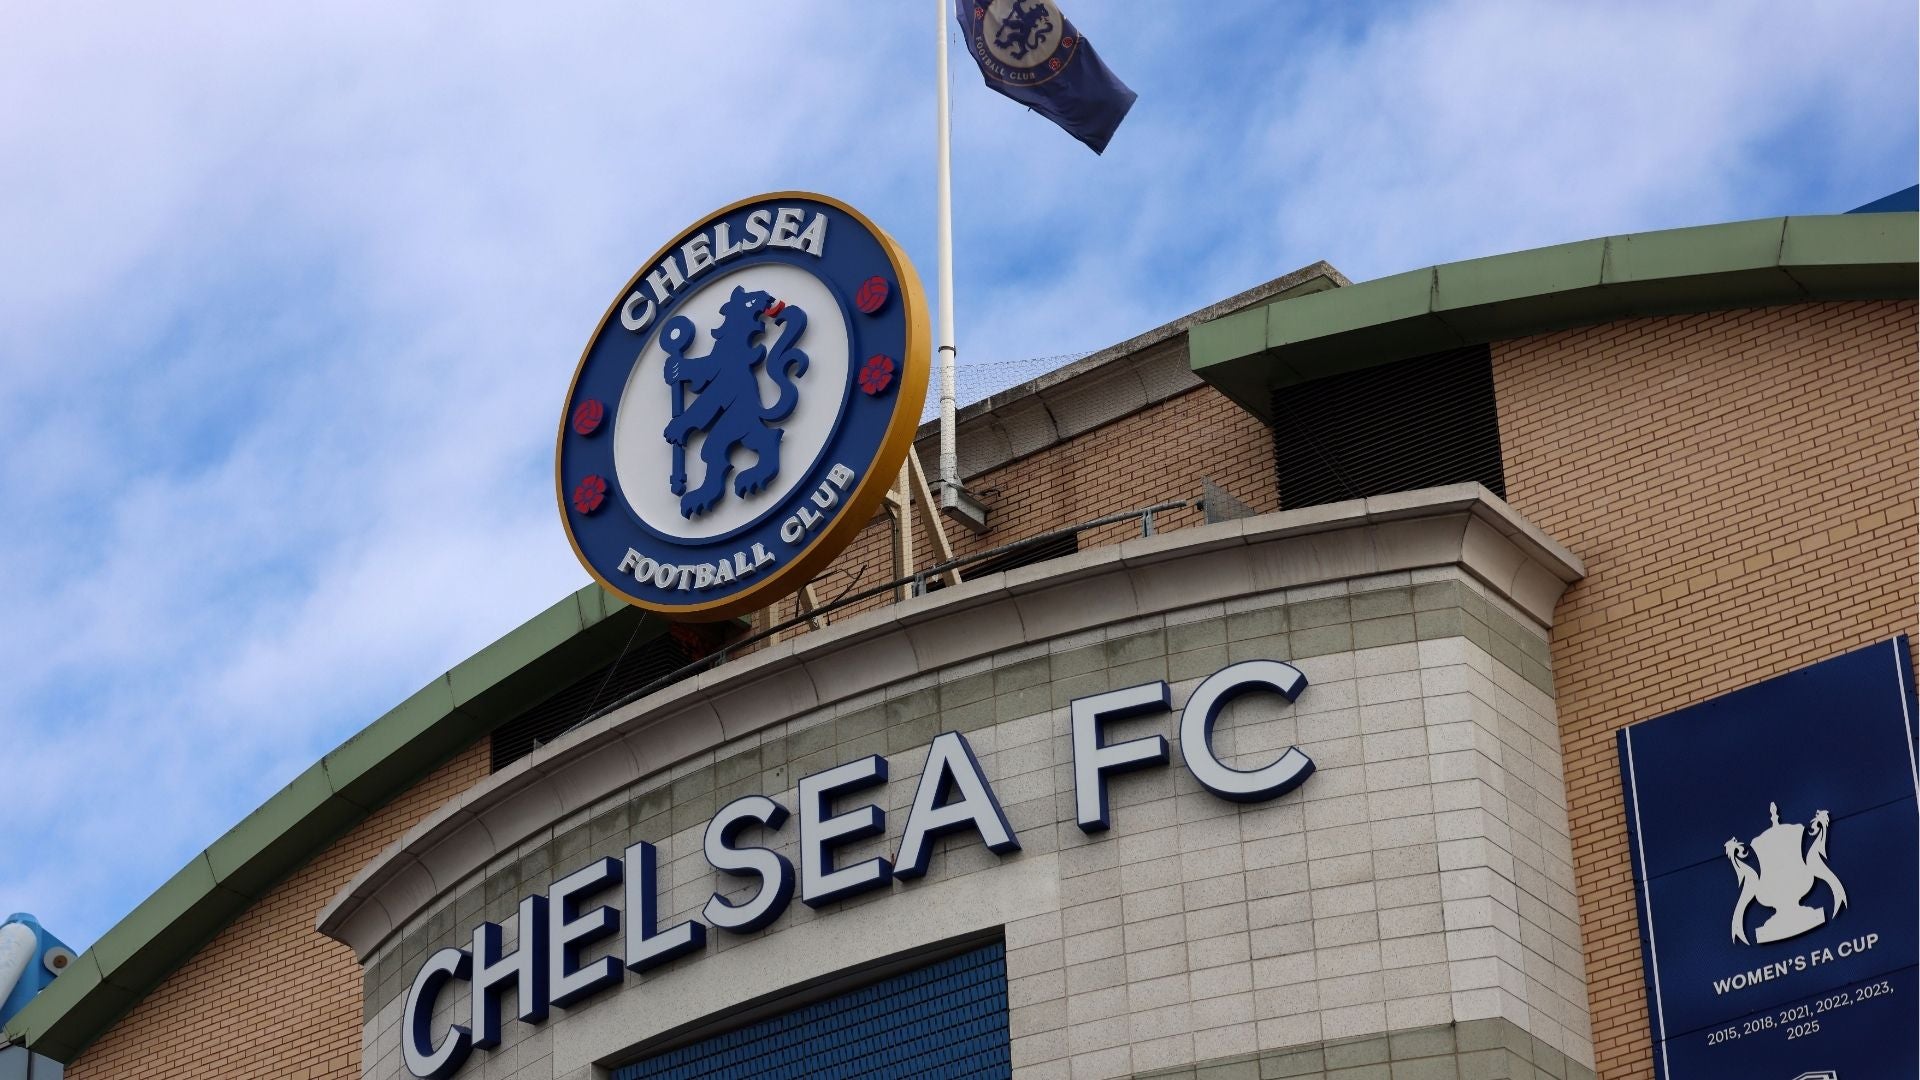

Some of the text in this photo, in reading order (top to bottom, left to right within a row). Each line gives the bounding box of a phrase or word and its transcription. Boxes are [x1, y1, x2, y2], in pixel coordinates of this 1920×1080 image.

[975, 36, 1036, 80] FOOTBALL CLUB
[620, 207, 829, 333] CHELSEA
[617, 462, 855, 591] FOOTBALL CLUB
[401, 658, 1316, 1080] CHELSEA FC
[1713, 933, 1879, 995] WOMEN'S FA CUP
[1707, 981, 1894, 1045] 2015, 2018, 2021, 2022, 2023,
[1787, 1020, 1820, 1040] 2025
